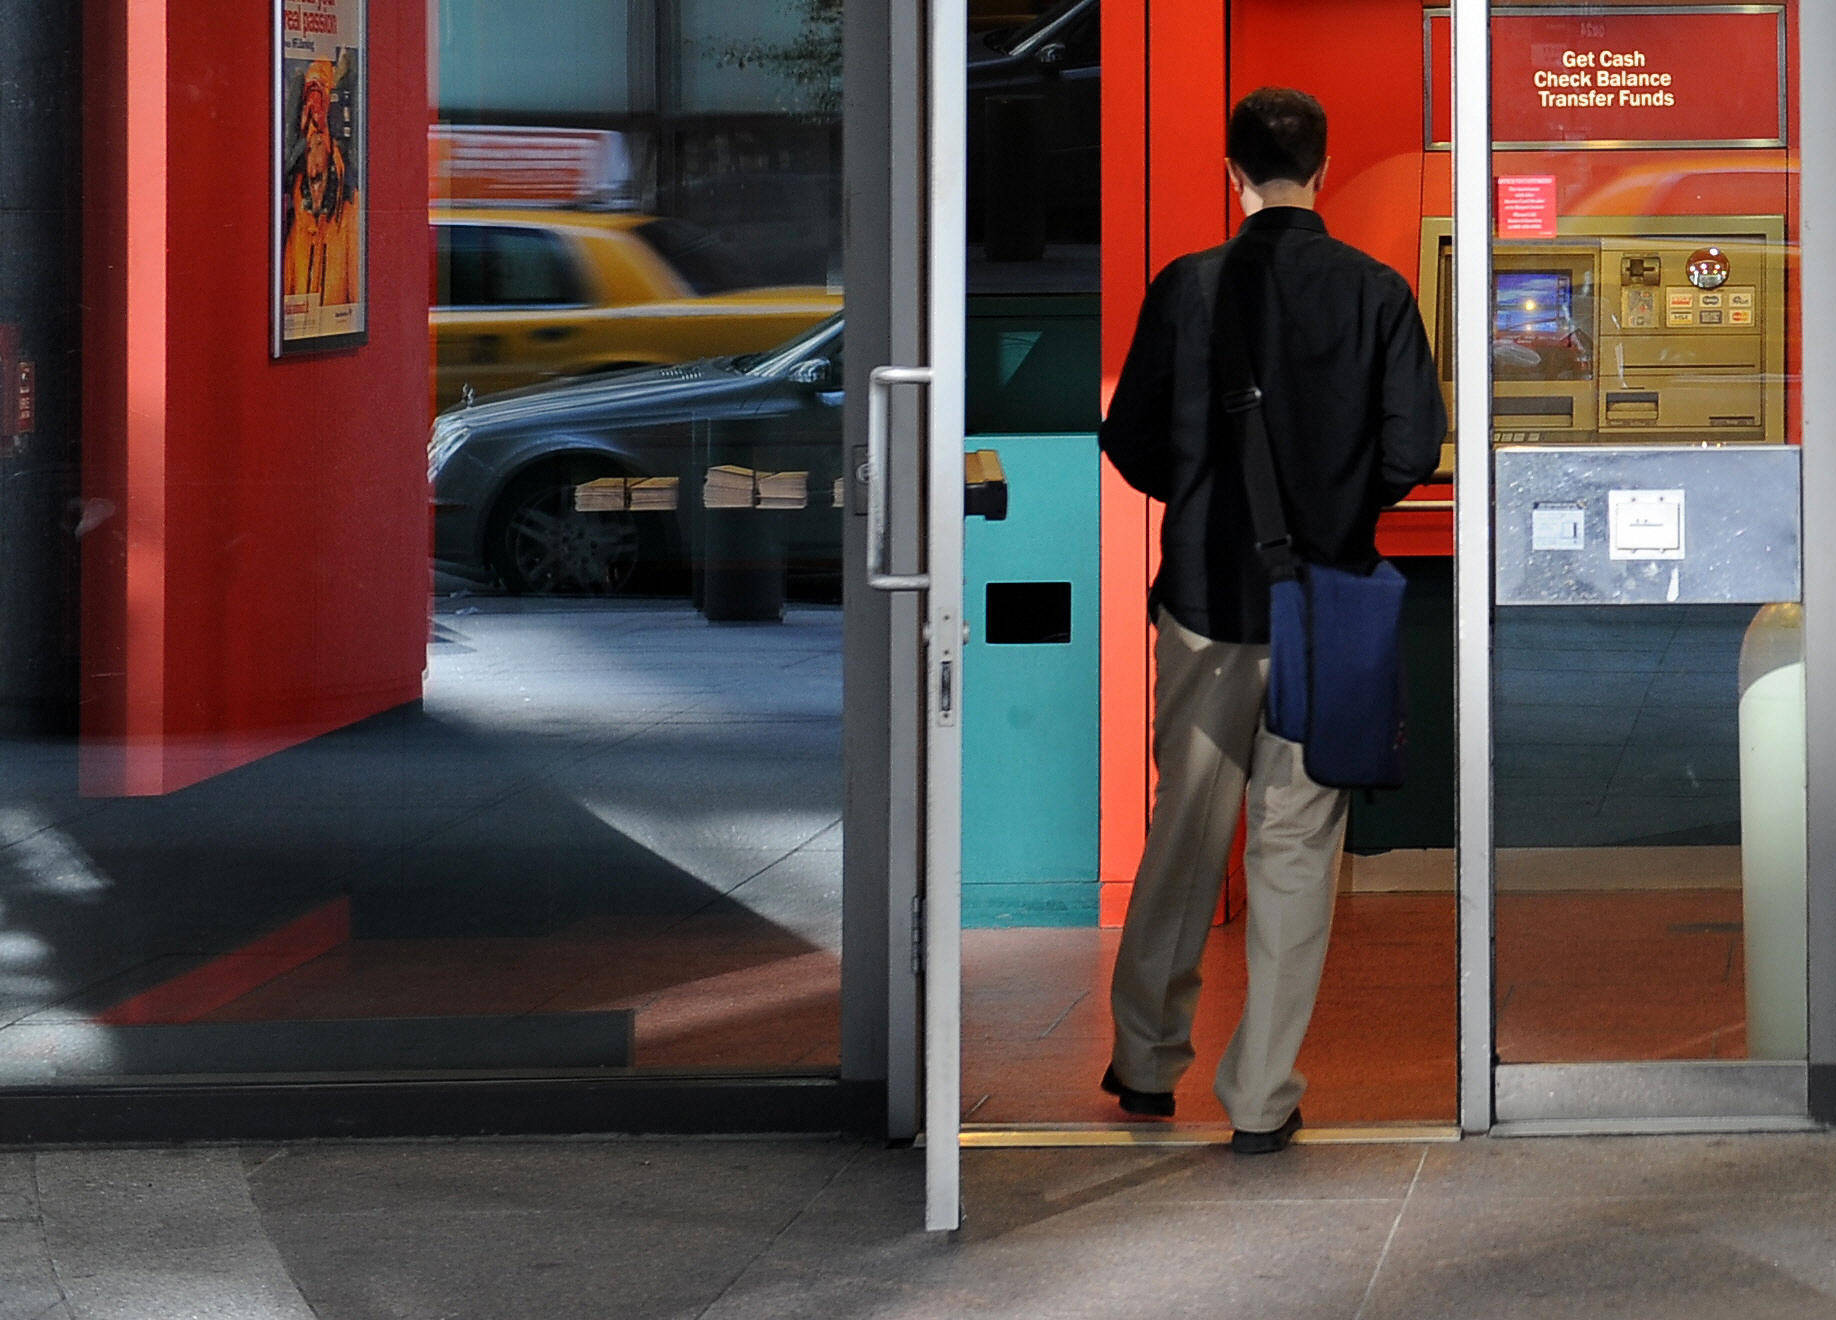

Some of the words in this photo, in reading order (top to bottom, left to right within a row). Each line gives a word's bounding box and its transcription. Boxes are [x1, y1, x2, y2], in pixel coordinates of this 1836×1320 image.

[303, 11, 338, 38] passion
[1562, 50, 1595, 67] Get
[1599, 50, 1646, 67] Cash
[1534, 71, 1592, 87] Check
[1597, 71, 1672, 87] Balance
[1538, 90, 1615, 107] Transfer
[1619, 90, 1675, 107] Funds
